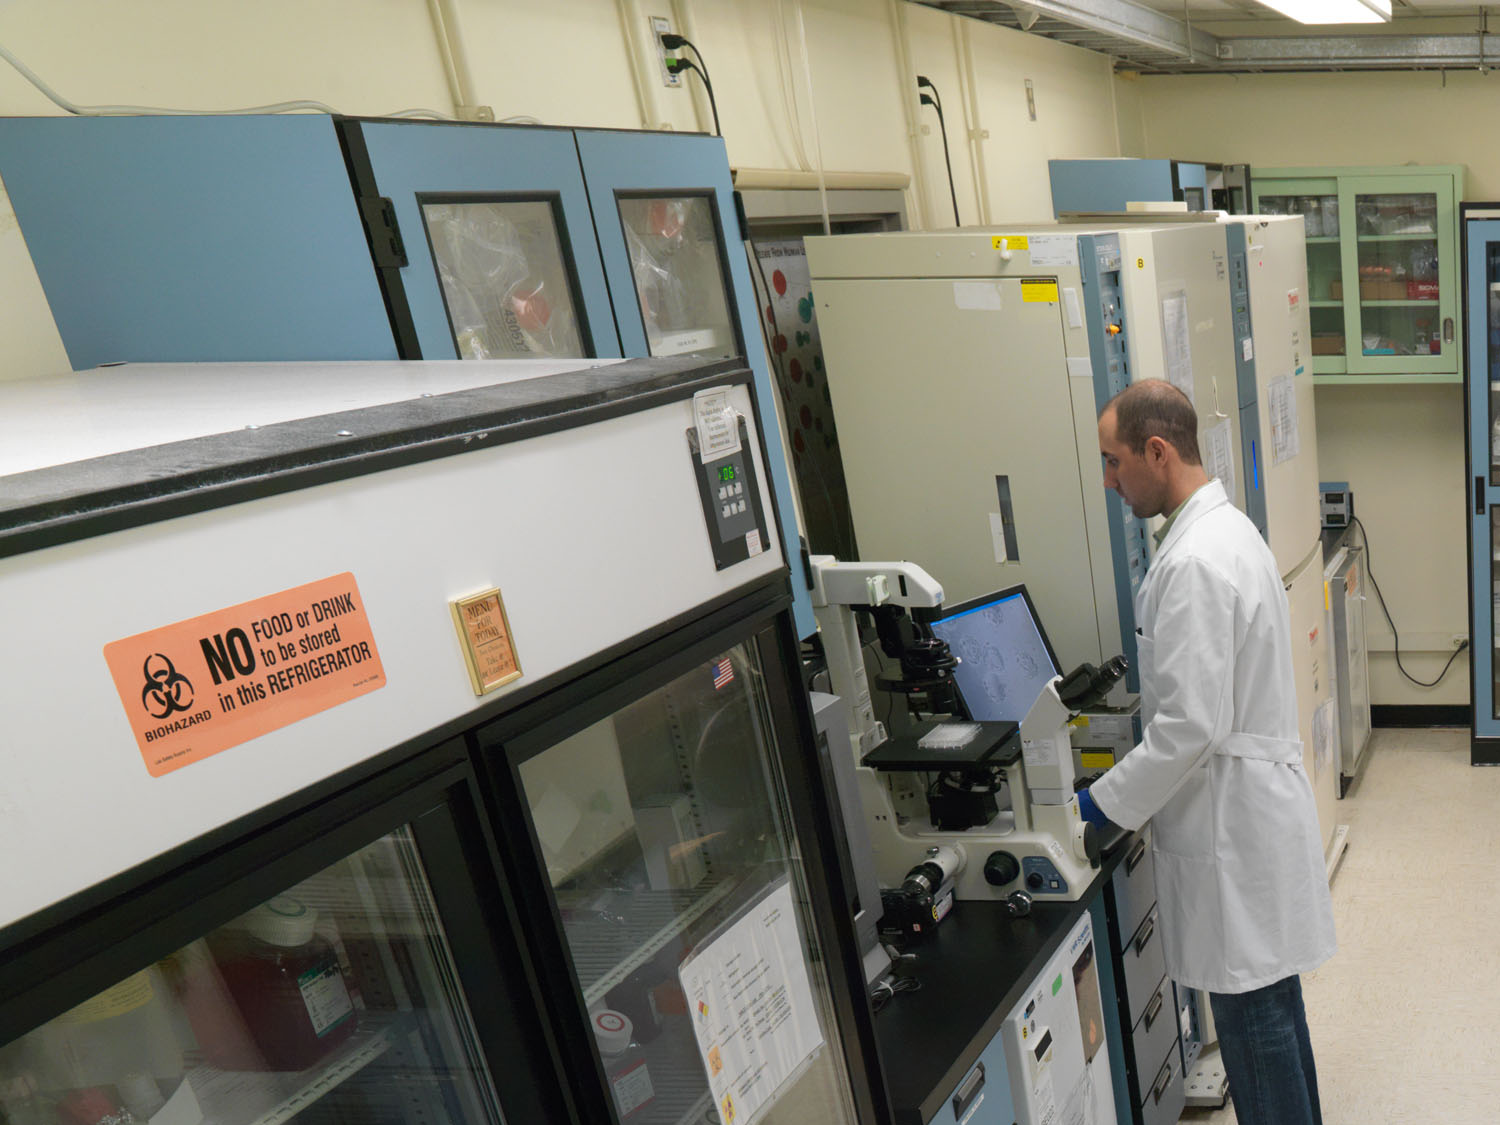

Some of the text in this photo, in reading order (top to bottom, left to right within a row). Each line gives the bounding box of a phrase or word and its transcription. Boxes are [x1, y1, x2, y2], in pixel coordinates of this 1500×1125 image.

[1137, 258, 1144, 268] B
[252, 592, 356, 642] FOOD or DRINK
[474, 626, 500, 642] TODAY
[199, 627, 256, 686] NO
[260, 624, 342, 667] to be stored
[218, 692, 236, 713] in
[236, 682, 266, 707] this
[267, 641, 372, 695] REFRIGERATOR
[144, 710, 212, 742] BIOHAZARD
